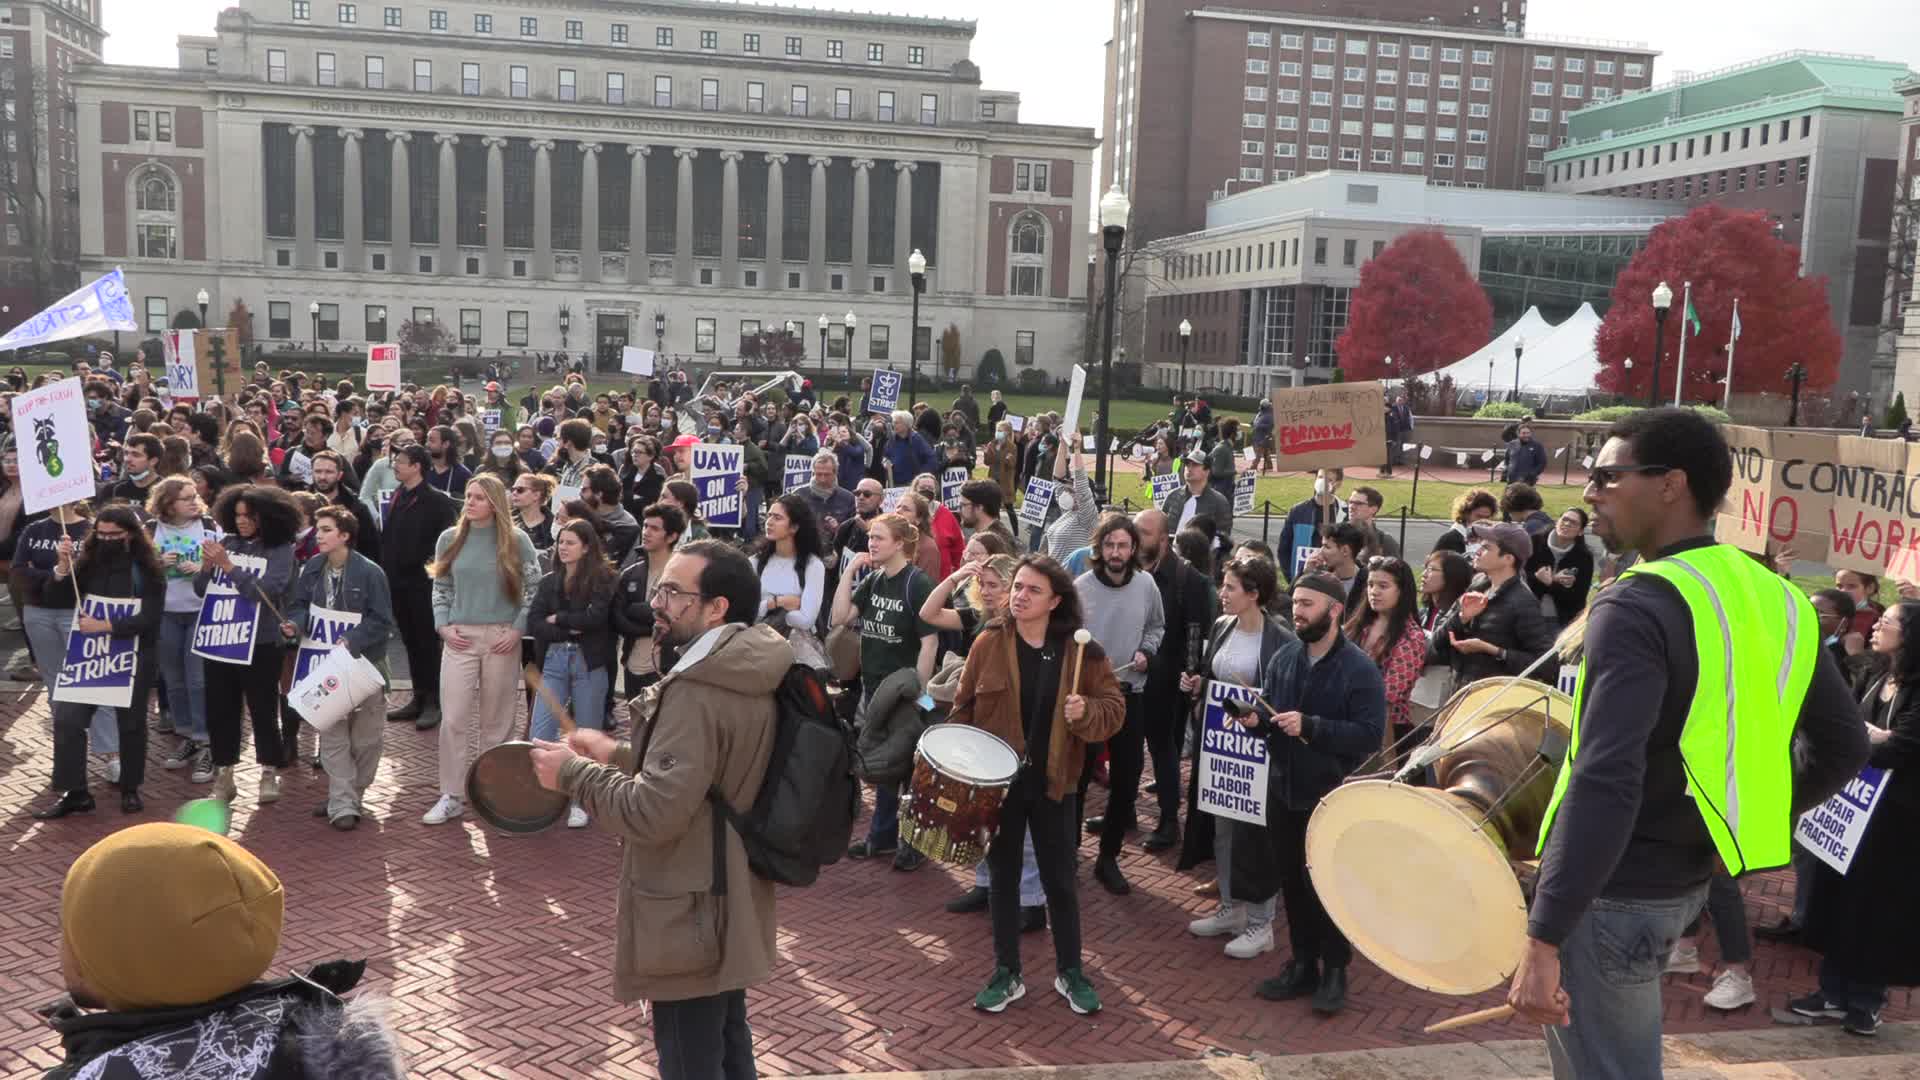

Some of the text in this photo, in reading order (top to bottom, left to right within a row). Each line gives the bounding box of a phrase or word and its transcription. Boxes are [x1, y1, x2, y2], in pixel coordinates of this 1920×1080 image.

[878, 386, 895, 396] CU
[693, 449, 739, 471] UAW
[787, 458, 812, 470] UAW
[1729, 446, 1764, 484] NO
[707, 478, 725, 498] ON
[942, 471, 966, 482] UAW
[1031, 478, 1054, 489] UAW
[1153, 474, 1177, 484] UAW
[693, 494, 738, 519] STRIKE
[1741, 488, 1920, 569] NO WORK
[211, 598, 237, 623] ON
[875, 610, 886, 622] IS
[195, 620, 252, 648] STRIKE
[876, 622, 897, 637] LIFE
[83, 633, 111, 659] ON
[59, 650, 132, 686] STRIKE
[1204, 728, 1265, 758] STRIKE
[1209, 756, 1255, 781] UNFAIR
[1210, 774, 1251, 797] LABOR
[1843, 776, 1875, 806] IKE
[1201, 787, 1261, 817] PRACTICE
[1824, 798, 1855, 825] NFAIR
[1812, 807, 1846, 841] LABOR
[1799, 817, 1849, 862] PRACTICE
